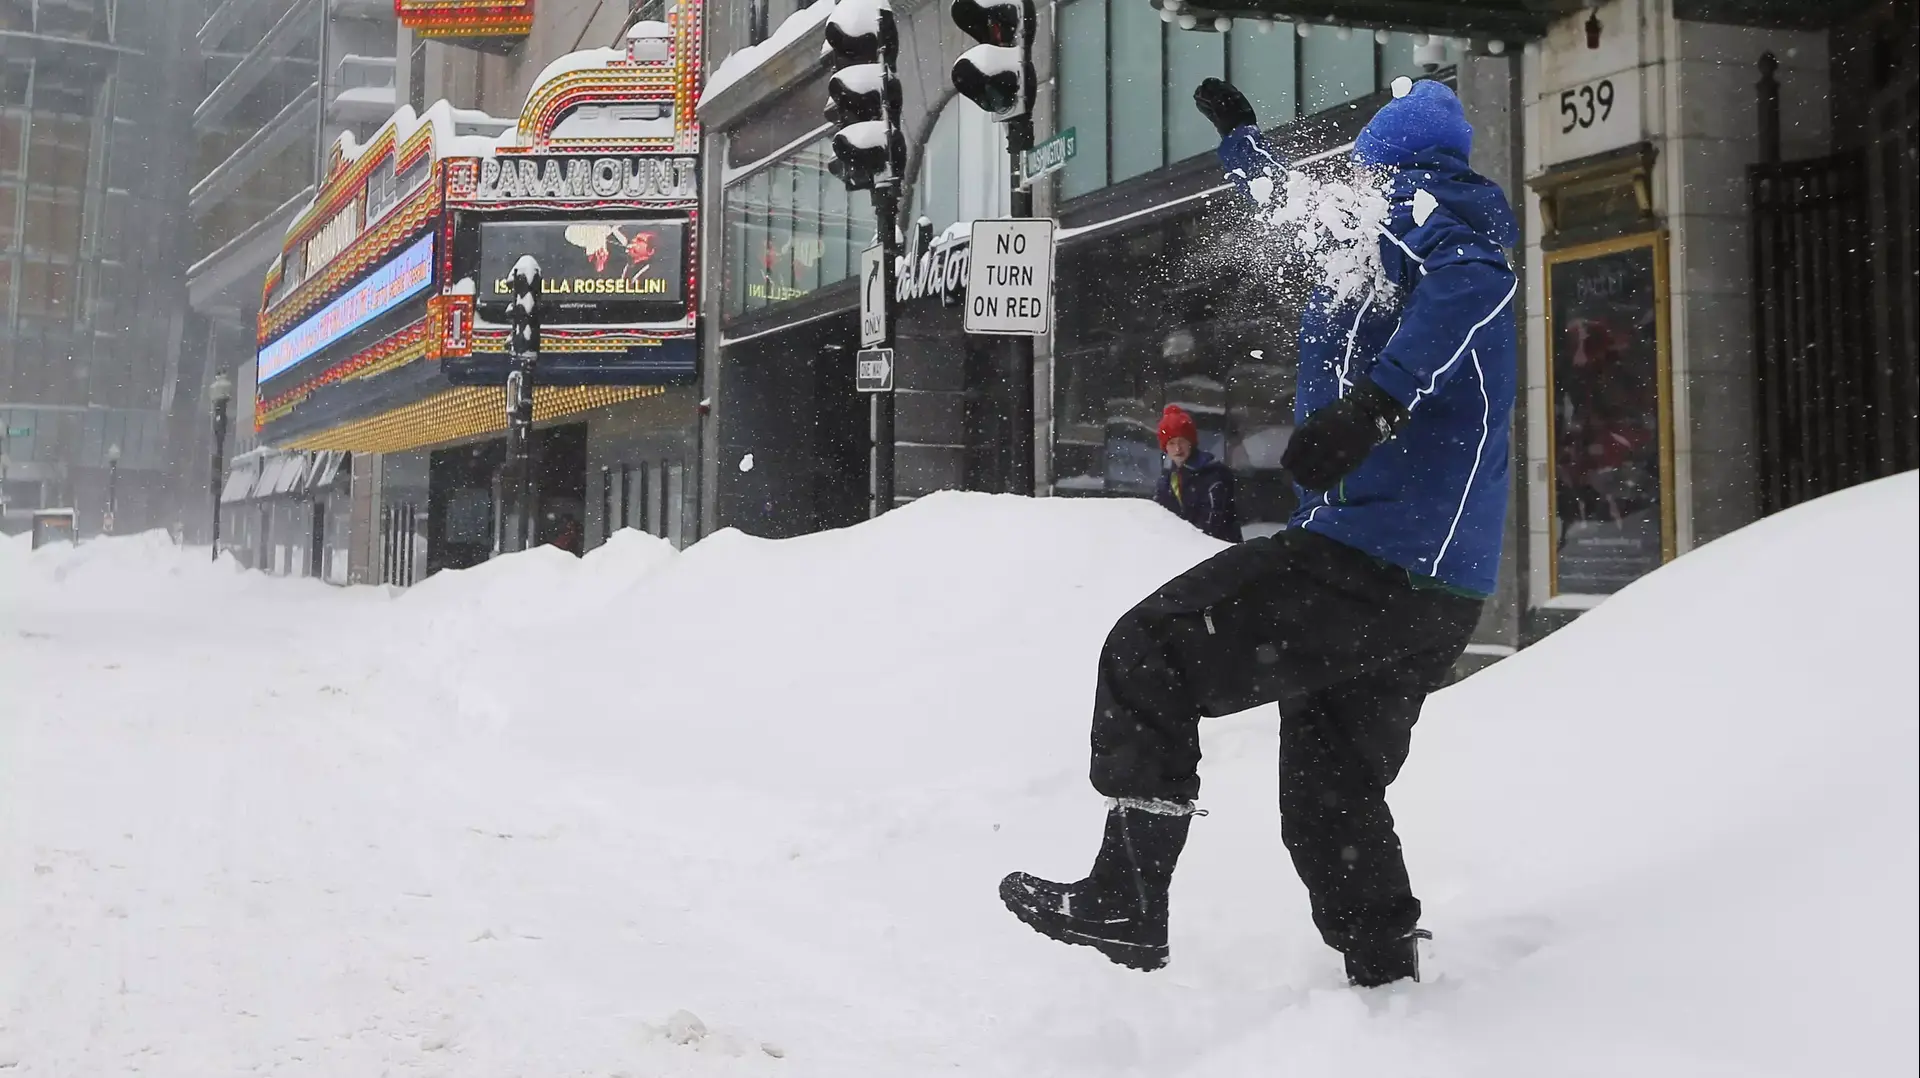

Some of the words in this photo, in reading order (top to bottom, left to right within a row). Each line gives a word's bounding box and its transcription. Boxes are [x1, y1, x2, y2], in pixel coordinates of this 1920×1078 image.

[1561, 80, 1614, 134] 539
[1028, 136, 1065, 174] WASHINGTON
[1067, 137, 1074, 156] ST
[481, 157, 696, 197] PARAMOUNT
[997, 233, 1026, 254] NO
[986, 265, 1033, 286] TURN
[494, 279, 570, 294] ISLLA
[573, 279, 666, 294] ROSSELLINI
[974, 296, 998, 317] ON
[1006, 297, 1042, 318] RED
[864, 315, 882, 336] ONLY
